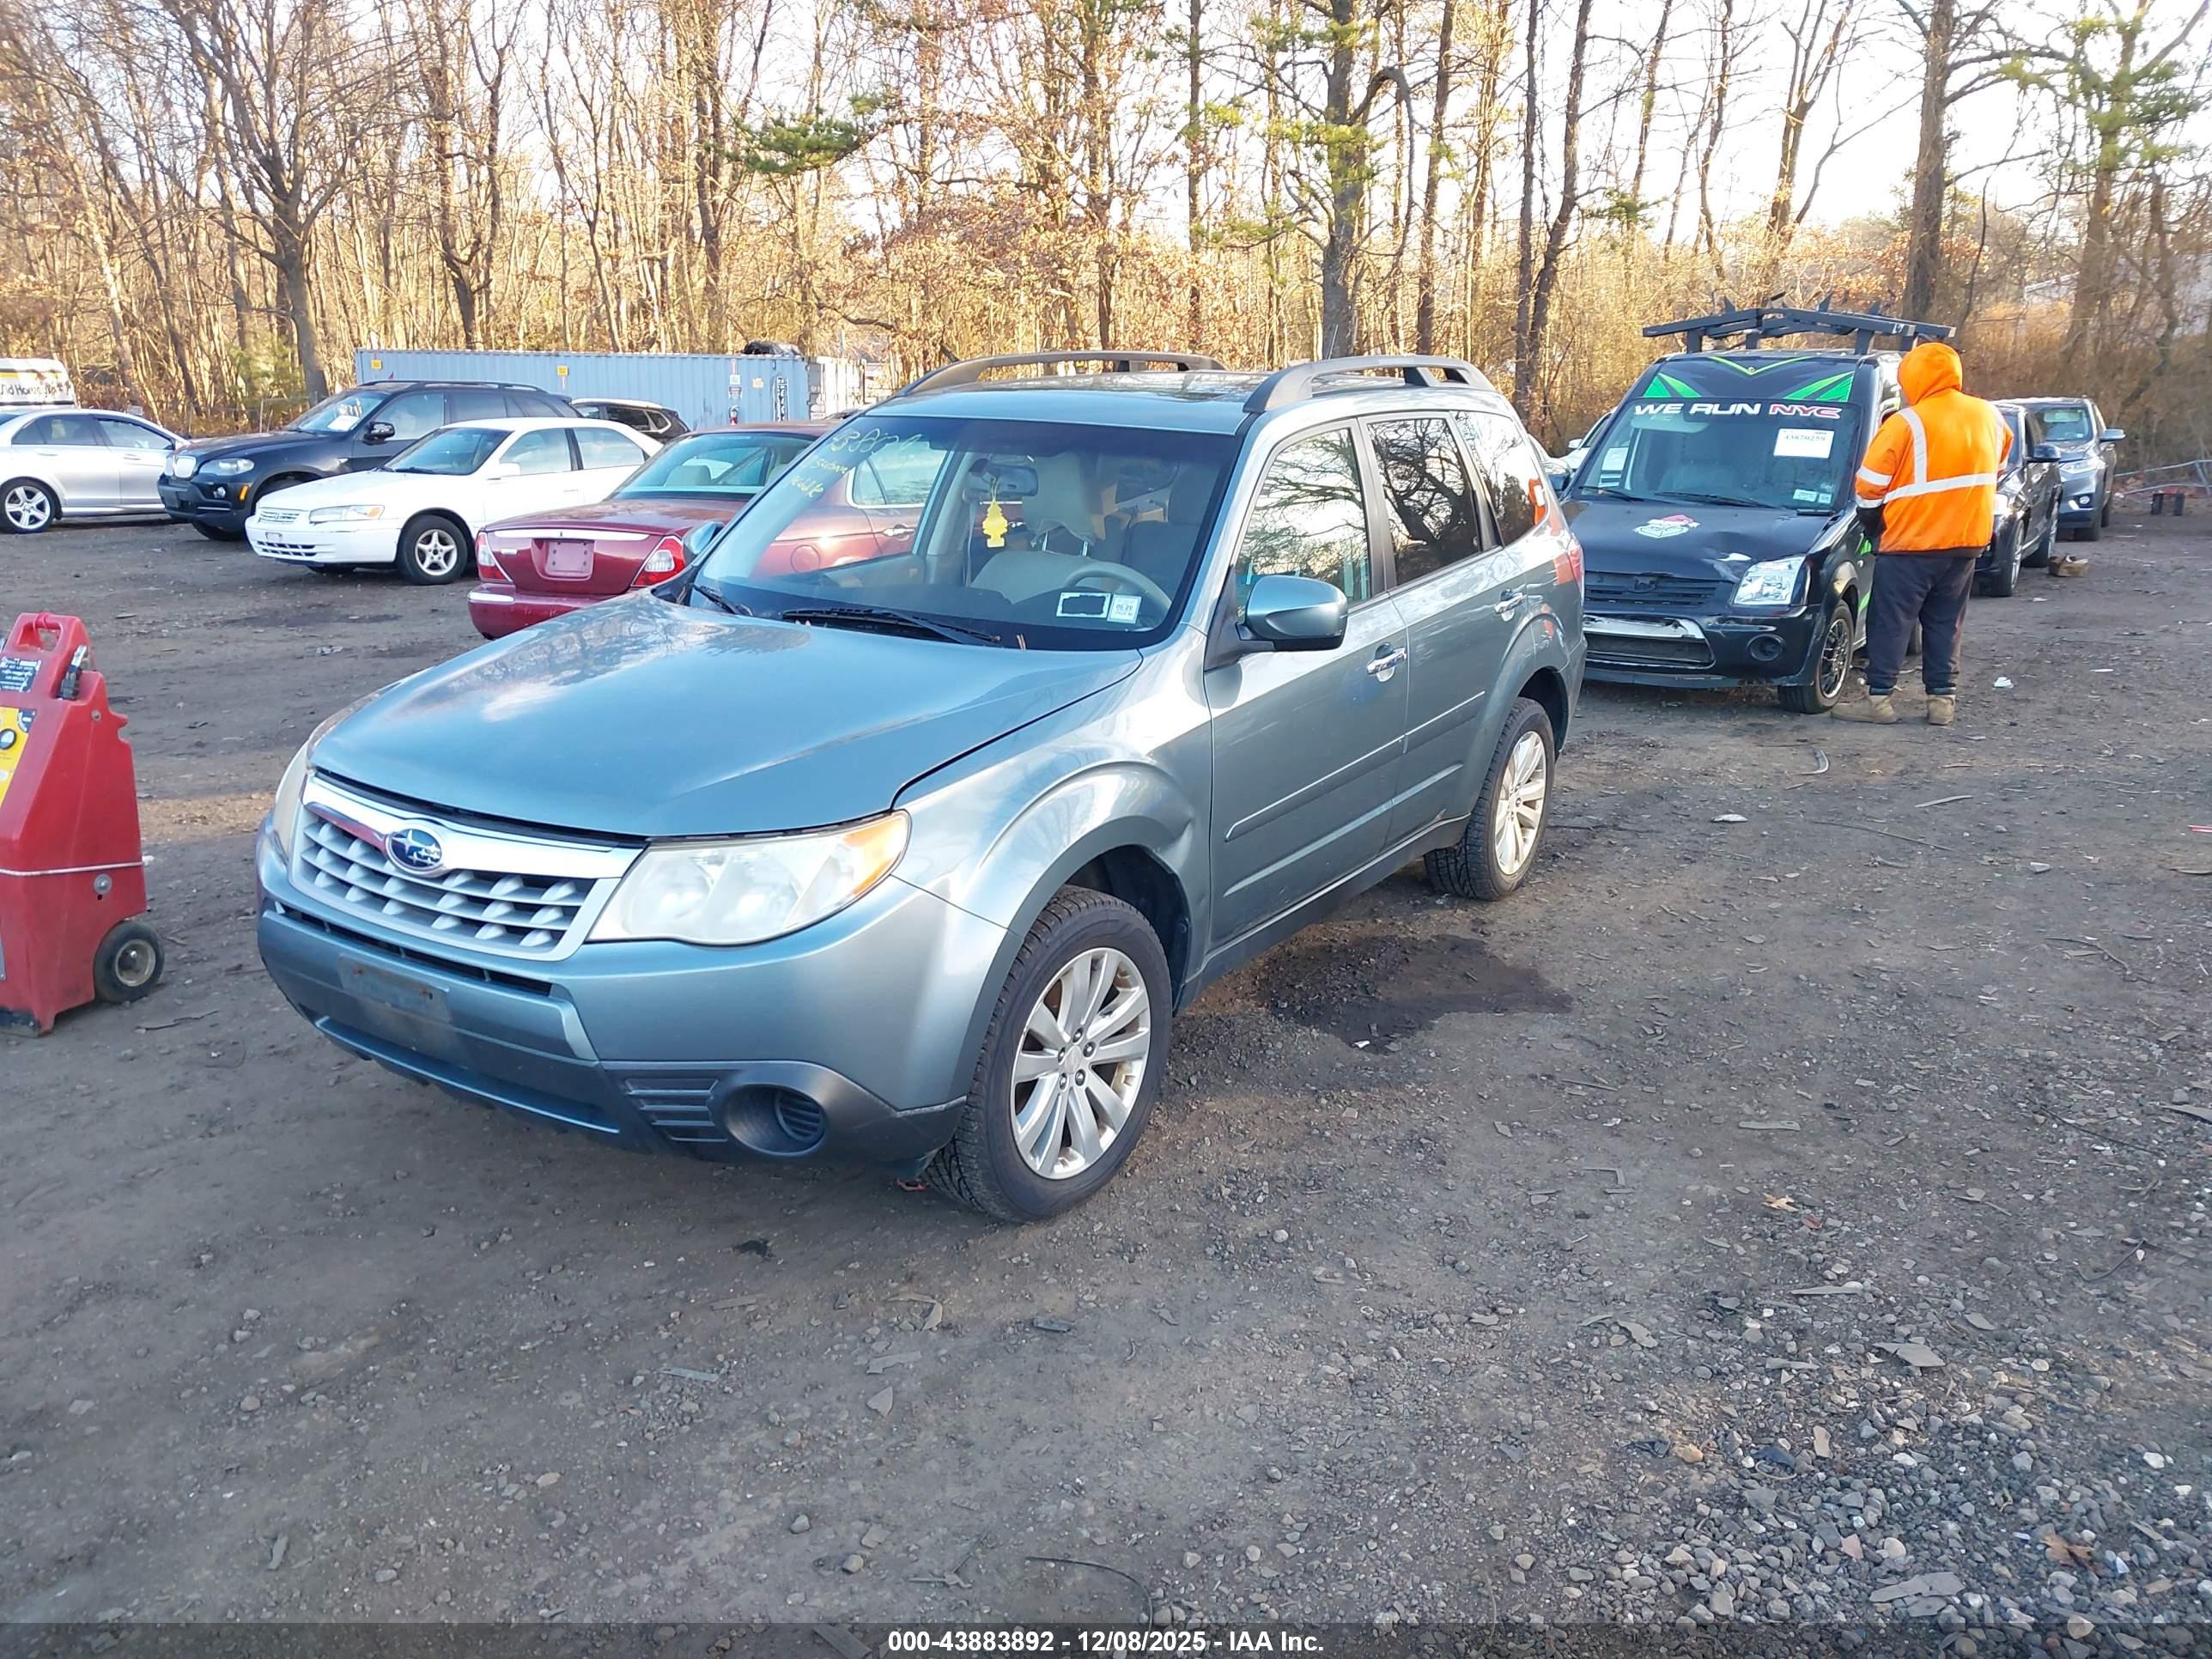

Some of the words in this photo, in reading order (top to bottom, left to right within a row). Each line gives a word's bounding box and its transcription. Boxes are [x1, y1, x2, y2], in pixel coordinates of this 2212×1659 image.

[1634, 403, 1684, 415] WE
[1689, 403, 1761, 415] RUN
[1769, 404, 1843, 419] NYC
